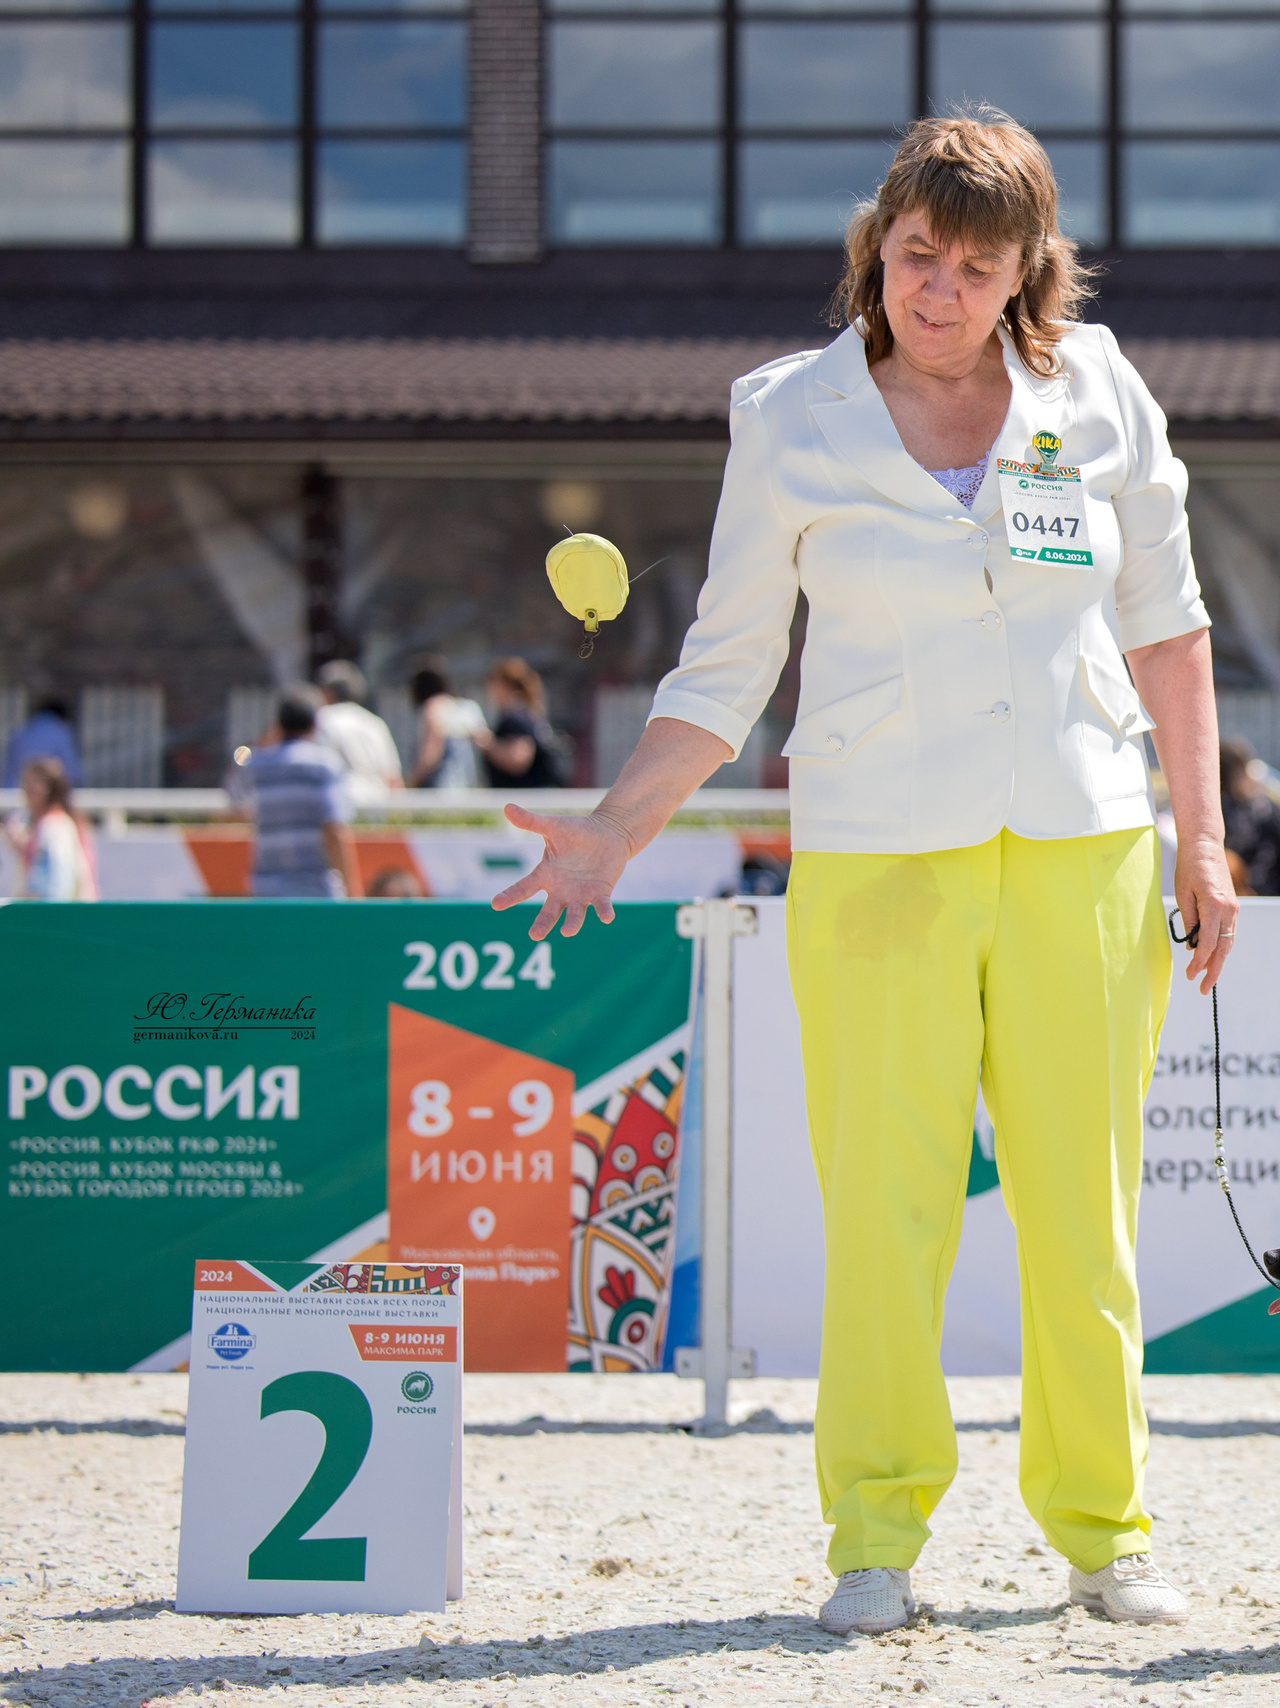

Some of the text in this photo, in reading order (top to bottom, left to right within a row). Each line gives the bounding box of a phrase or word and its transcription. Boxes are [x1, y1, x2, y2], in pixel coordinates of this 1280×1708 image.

[1033, 435, 1062, 450] KIKA
[1031, 482, 1063, 491] РОССИЯ
[1012, 511, 1080, 538] 0447
[1045, 551, 1088, 562] 8.06.2024
[403, 940, 556, 991] 2024
[8, 1064, 300, 1121] РОССИЯ
[109, 1135, 174, 1154] КУБОК
[109, 1161, 174, 1179] КУБОК
[178, 1161, 265, 1179] МОСКВЫ
[410, 1150, 554, 1183] ИЮНЯ
[200, 1270, 233, 1283] 2024
[200, 1295, 285, 1304] НАЦИОНАЛЬНЫЕ
[289, 1296, 342, 1305] ВЫСТАВКИ
[412, 1300, 446, 1308] ПОРОД
[206, 1307, 291, 1315] НАЦИОНАЛЬНЫЕ
[294, 1308, 381, 1317] МОНОПОРОДНЫЕ
[211, 1336, 253, 1348] Farmina
[364, 1332, 445, 1345] 8-9 ИЮНЯ
[364, 1346, 444, 1356] МАКСИМА ПАРК
[397, 1406, 437, 1414] РОССИЯ
[247, 1371, 373, 1582] 2
